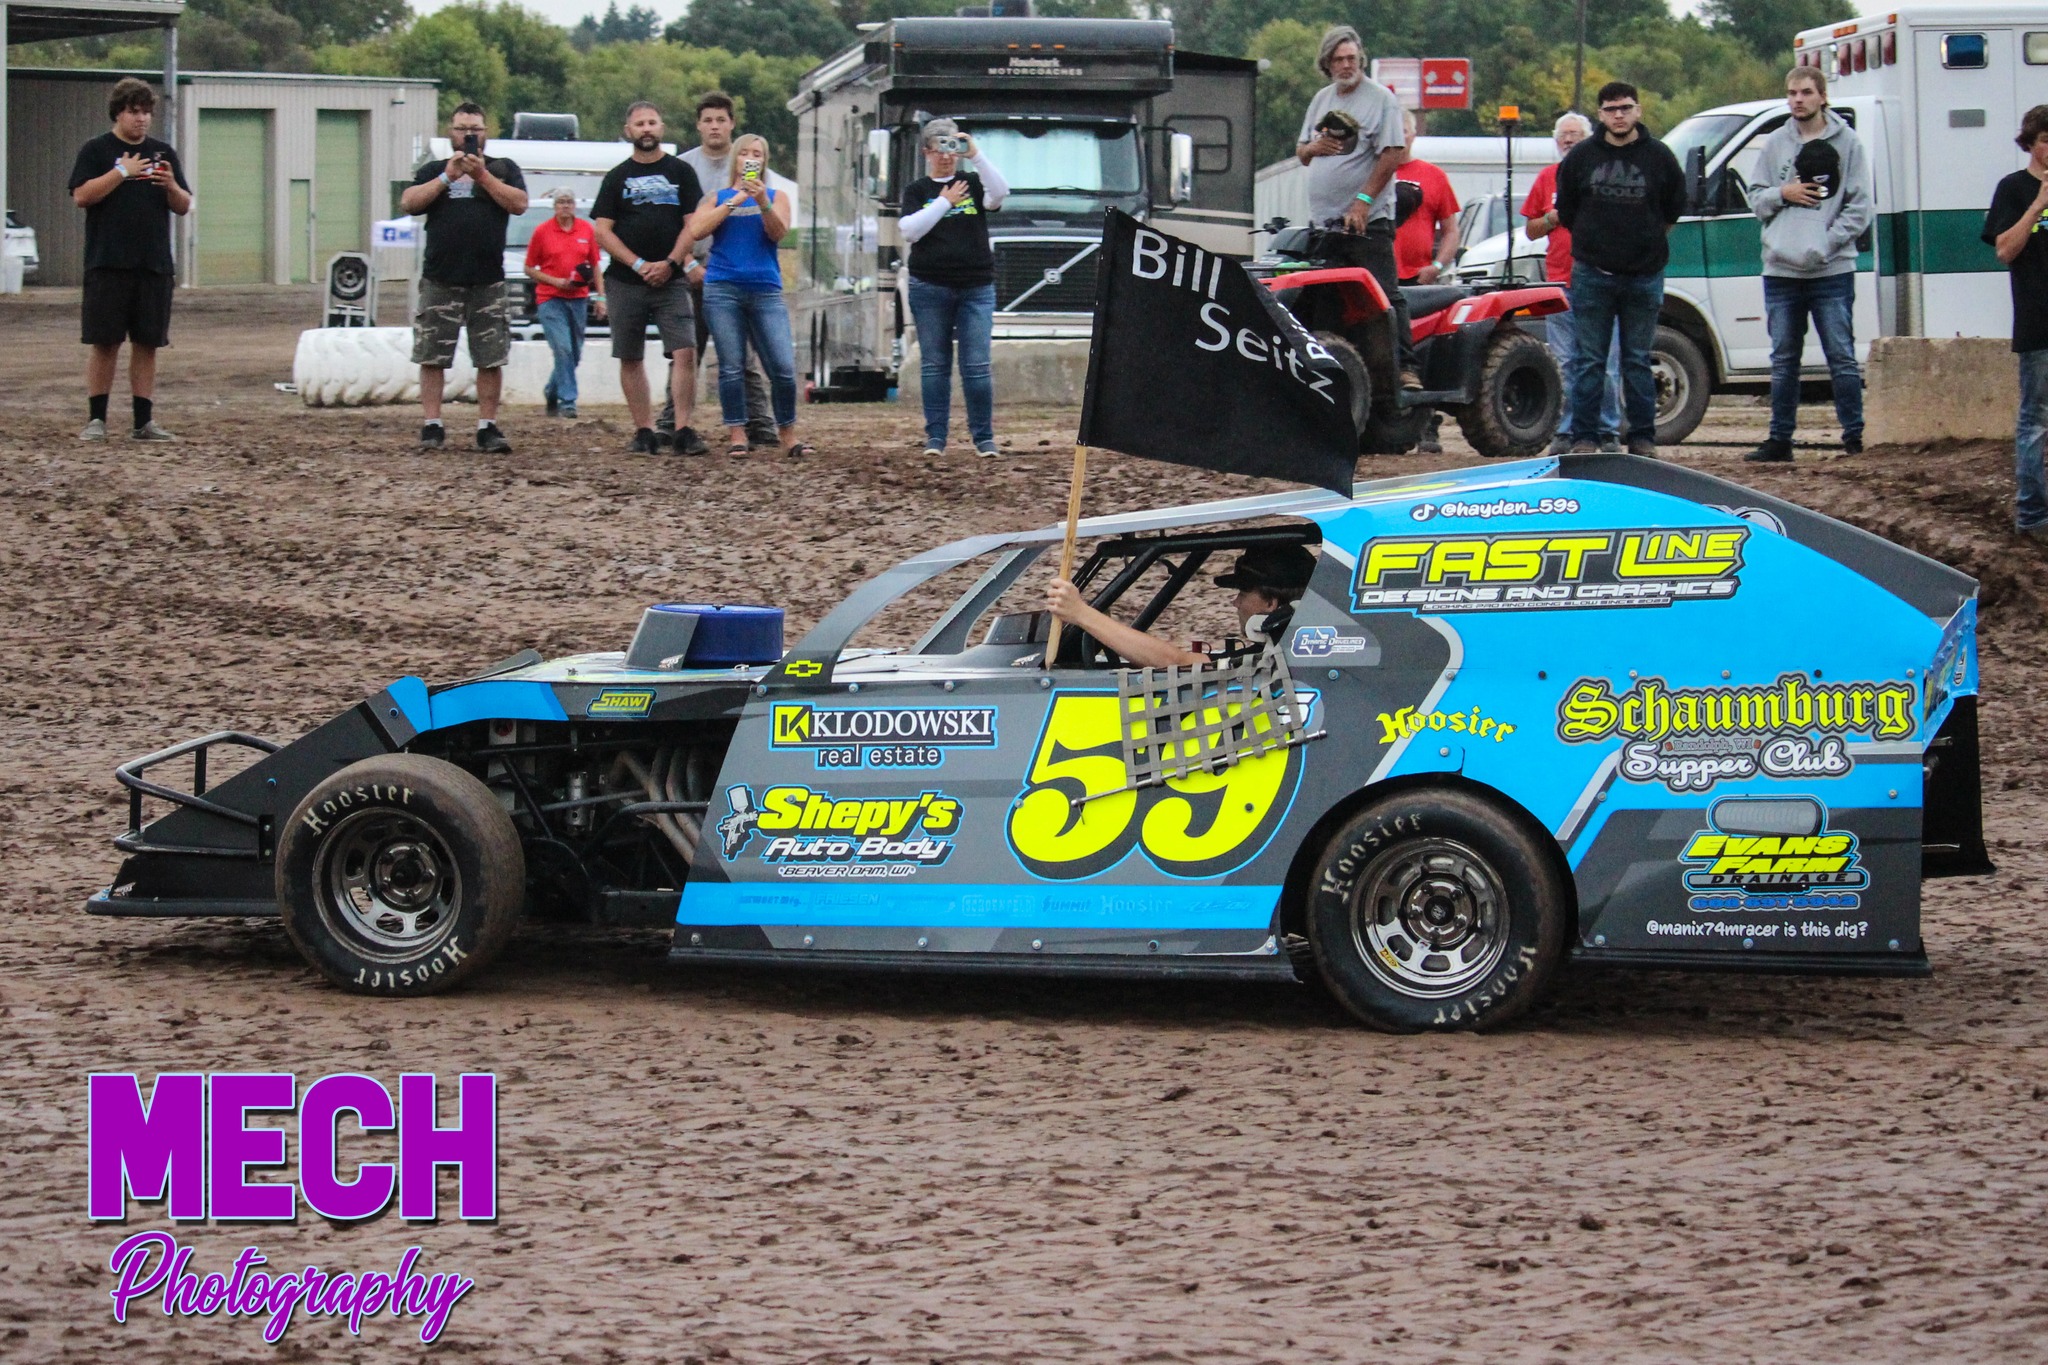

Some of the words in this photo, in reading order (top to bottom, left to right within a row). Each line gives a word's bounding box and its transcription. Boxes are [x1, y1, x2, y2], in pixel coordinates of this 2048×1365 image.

[1132, 229, 1222, 300] Bill
[1195, 302, 1335, 404] Seitz
[1440, 498, 1579, 518] @hayden_59s
[1363, 538, 1610, 584] FAST
[1618, 533, 1743, 577] LINE
[1362, 588, 1501, 603] DESIGNS
[1506, 586, 1571, 600] AND
[1576, 581, 1735, 598] GRAPHICS
[811, 710, 992, 737] KLODOWSKI
[1376, 705, 1518, 744] Hoosier
[1564, 680, 1910, 741] Schaumburg
[819, 744, 860, 764] real
[871, 747, 939, 764] estate
[1626, 741, 1752, 784] Supper
[1763, 739, 1846, 772] Club
[1011, 696, 1290, 862] 59
[302, 784, 415, 837] Hoosier
[757, 787, 957, 836] Shepy's
[765, 837, 851, 857] Auto
[857, 837, 948, 859] Body
[1321, 813, 1422, 904] Hoosier
[1687, 835, 1851, 857] EVANS
[1712, 856, 1849, 875] FARM
[783, 867, 846, 876] BEAVER
[1711, 873, 1848, 884] DRAINAGE
[1646, 921, 1779, 937] @manix74mracer
[1784, 921, 1797, 936] is
[1801, 921, 1830, 936] this
[1835, 921, 1868, 939] dig?
[354, 936, 468, 988] Hoosier
[1434, 945, 1538, 1024] Hoosier
